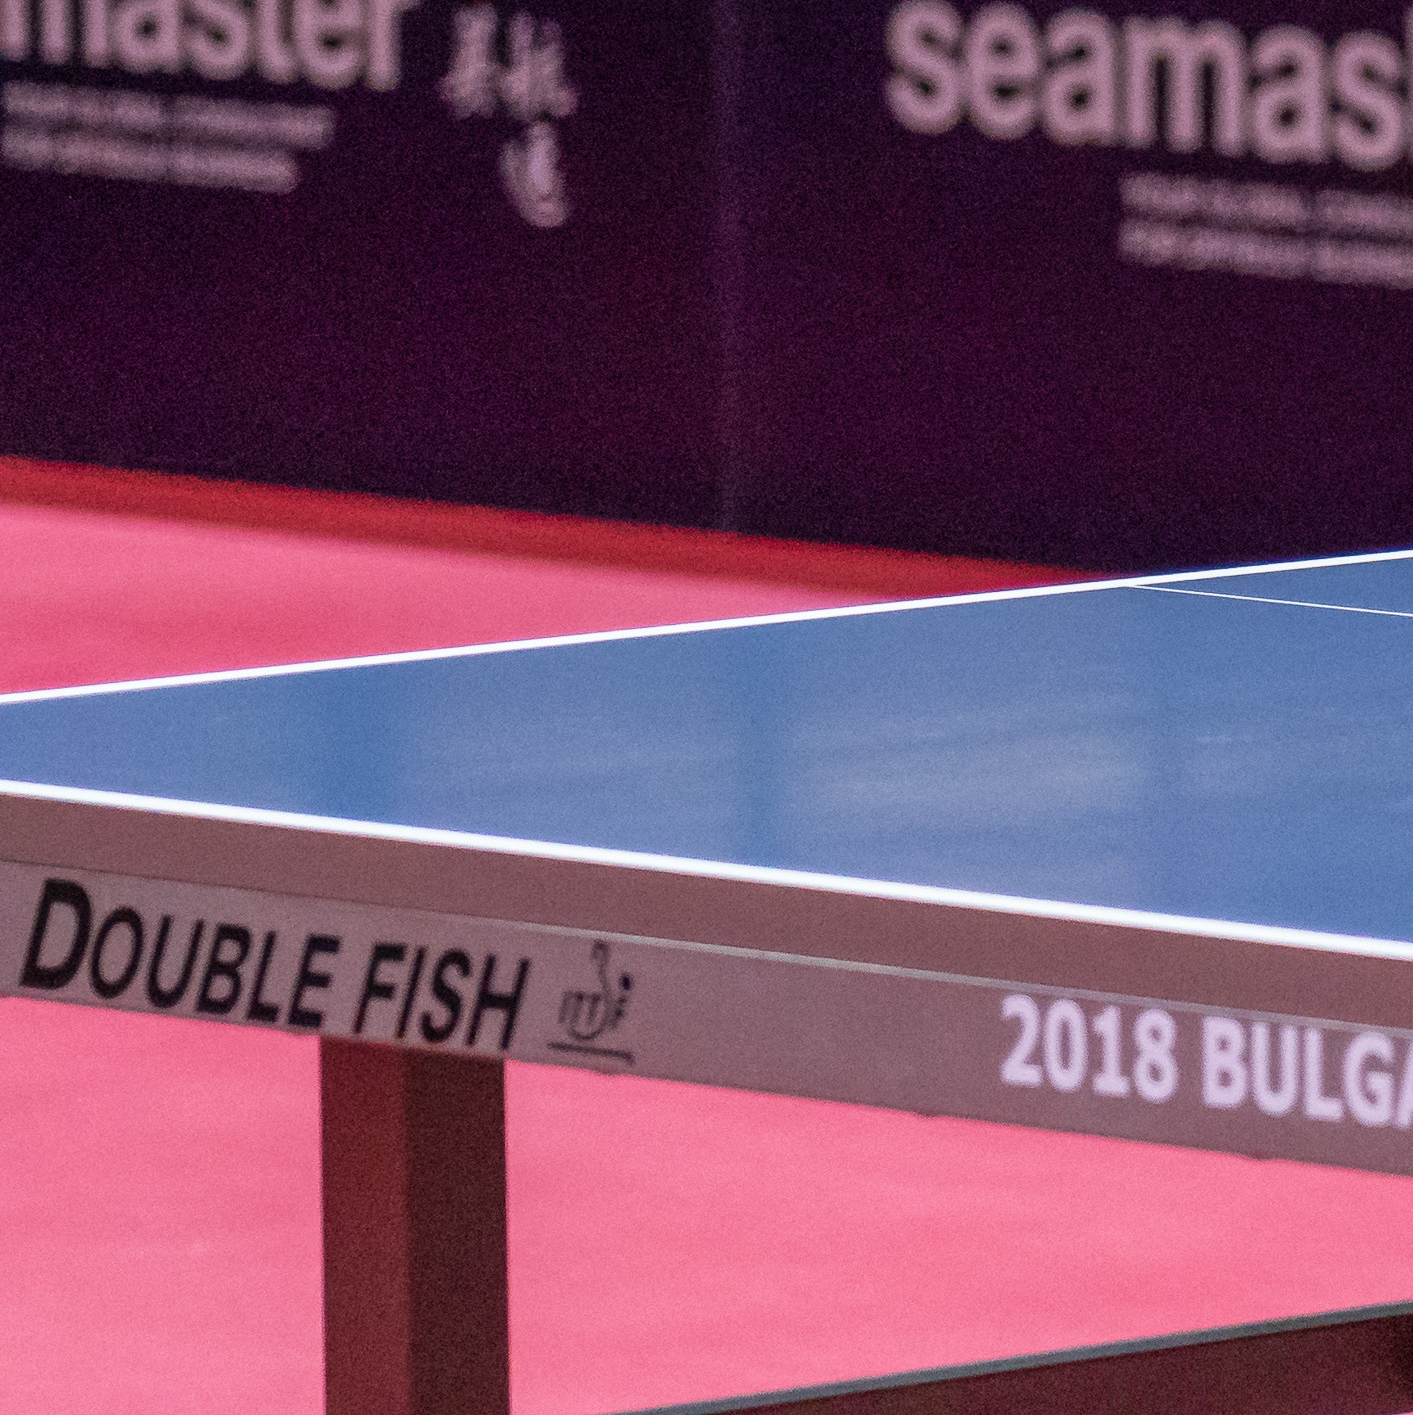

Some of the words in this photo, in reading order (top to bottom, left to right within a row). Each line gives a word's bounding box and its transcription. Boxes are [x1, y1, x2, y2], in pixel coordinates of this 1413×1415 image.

[19, 877, 340, 1029] DOUBLE
[353, 942, 532, 1051] FISH
[1000, 994, 1180, 1103] 2018
